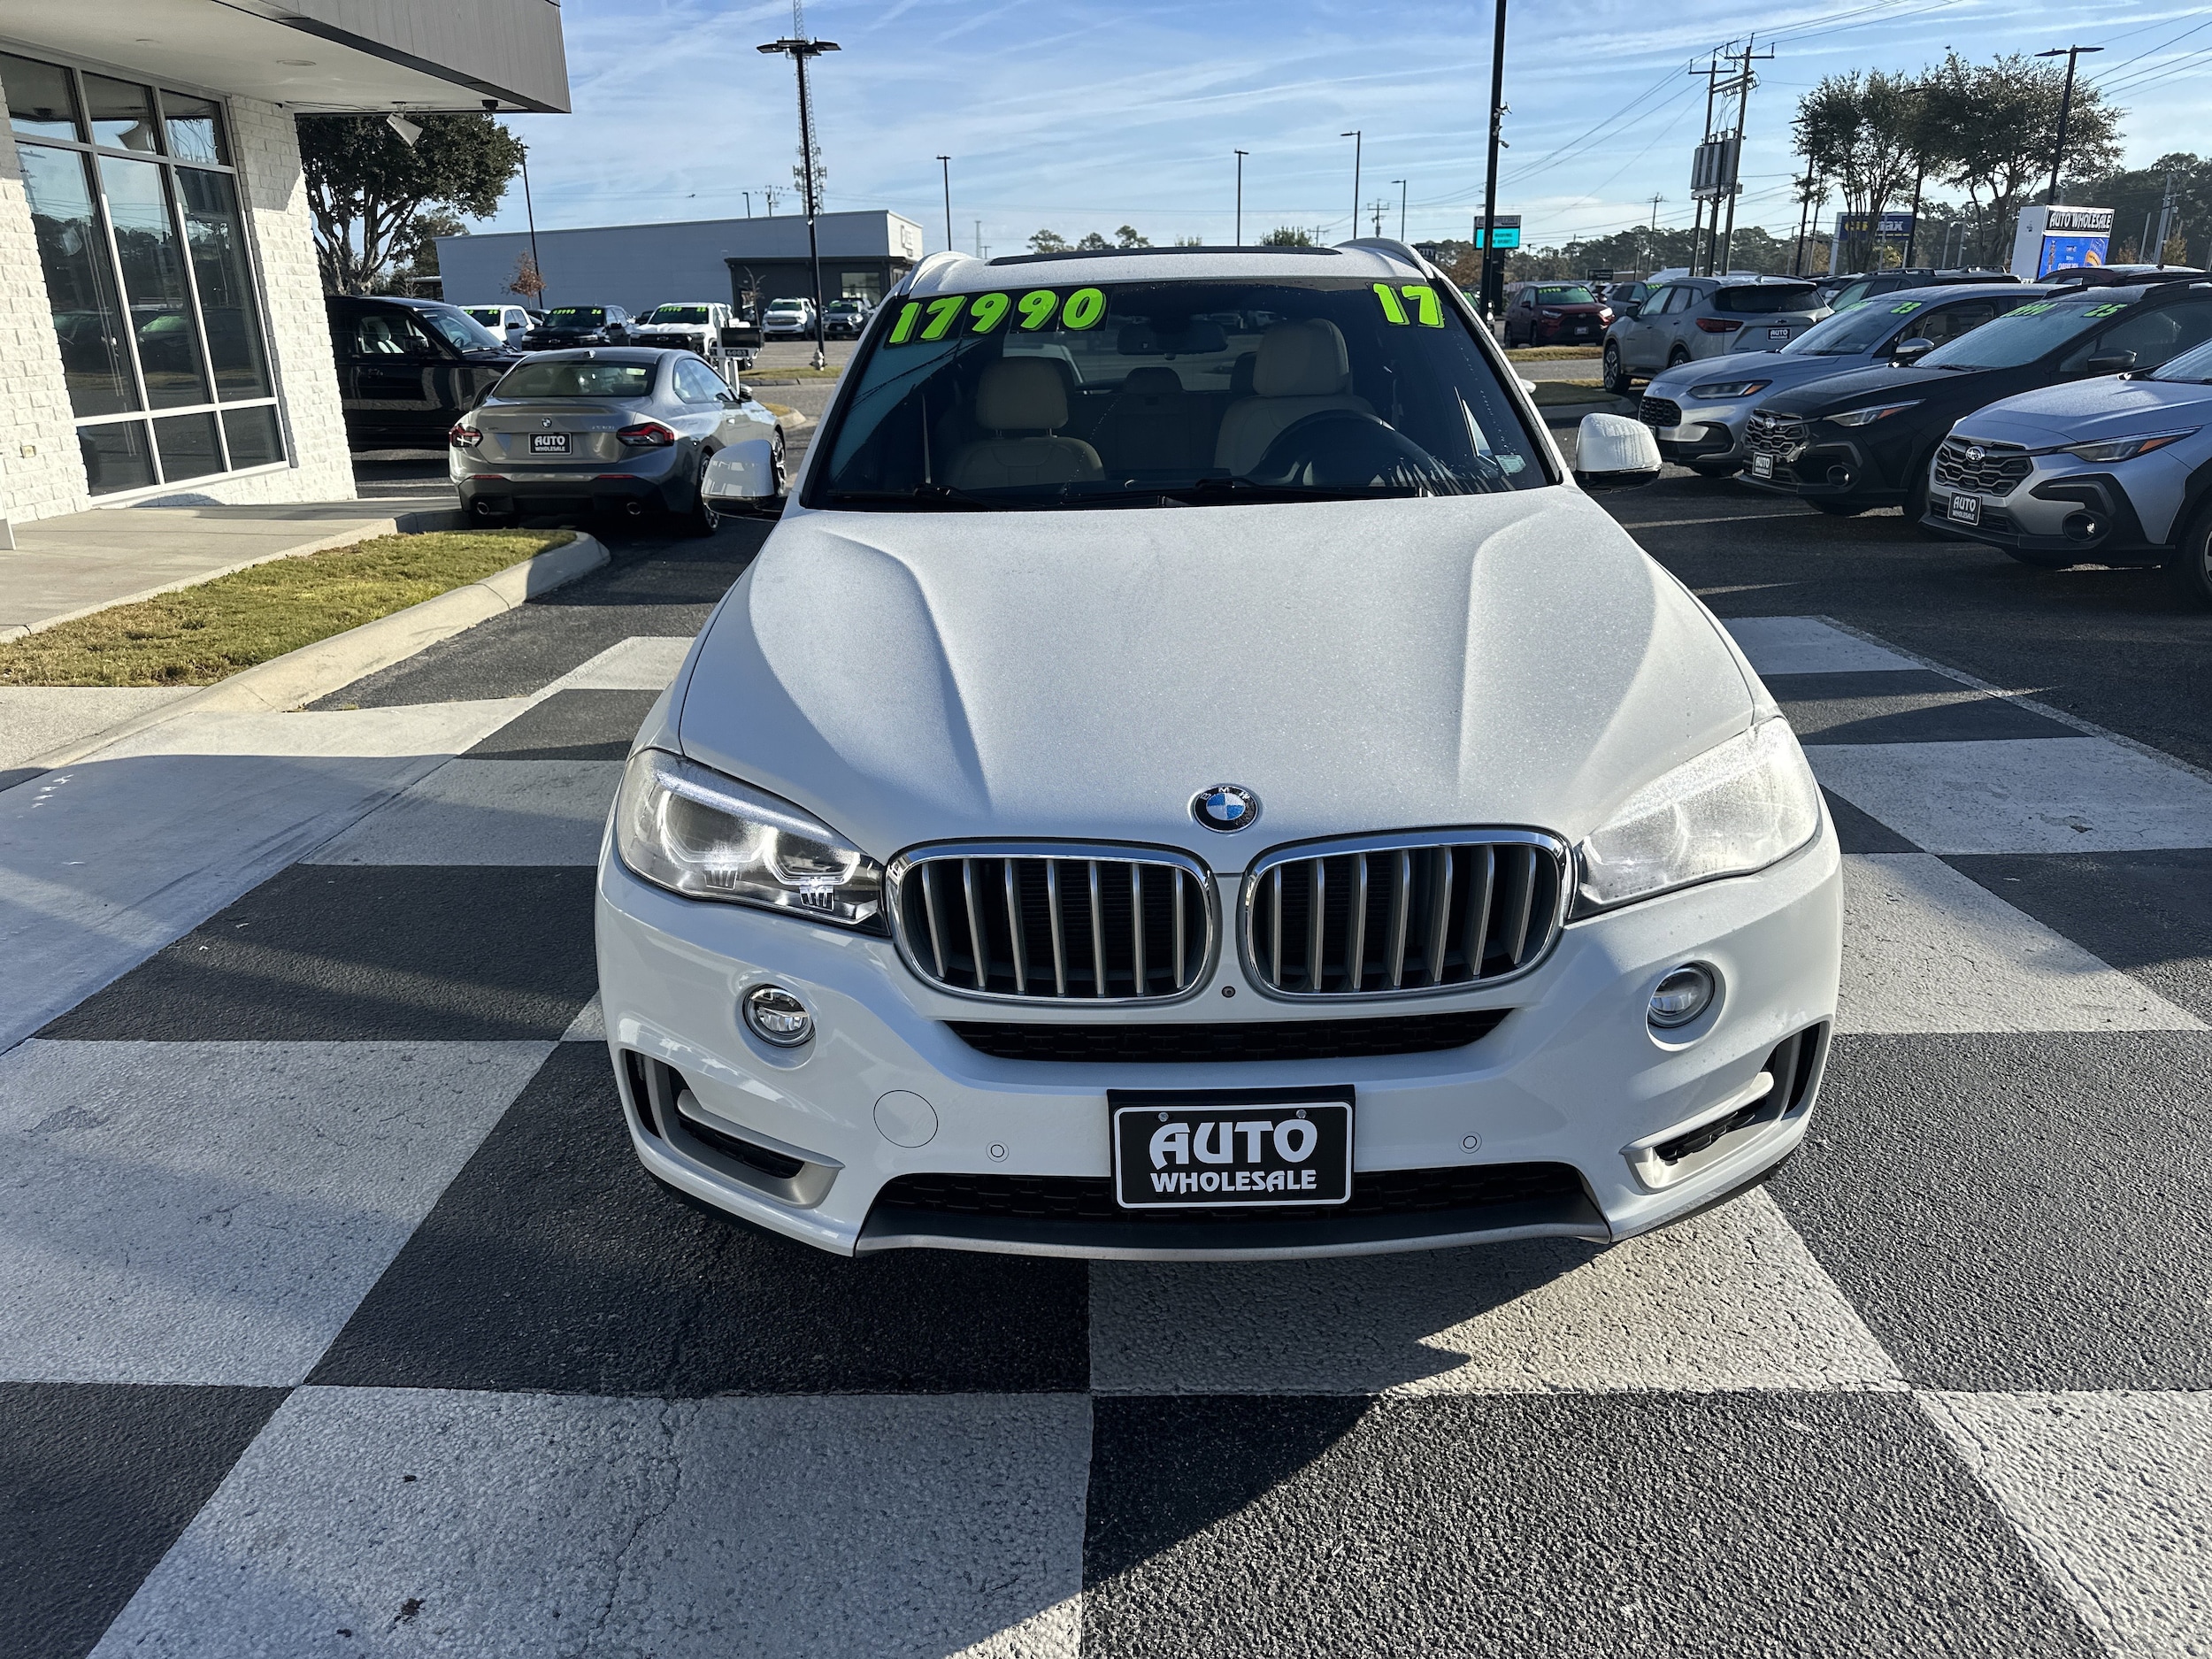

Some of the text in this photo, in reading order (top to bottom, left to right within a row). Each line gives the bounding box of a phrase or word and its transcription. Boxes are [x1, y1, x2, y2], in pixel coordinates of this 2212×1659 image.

[2049, 211, 2112, 229] AUTO WHOLESALE
[1373, 283, 1447, 329] 17
[1890, 302, 1922, 314] 23
[2083, 303, 2128, 318] 25
[890, 288, 1107, 345] 17990
[534, 435, 565, 446] AUTO
[1755, 457, 1770, 468] AUTO
[1954, 496, 1977, 512] AUTO
[1952, 511, 1975, 520] WHOLESALE
[1148, 1119, 1317, 1171] AUTO
[1150, 1169, 1317, 1194] WHOLESALE
